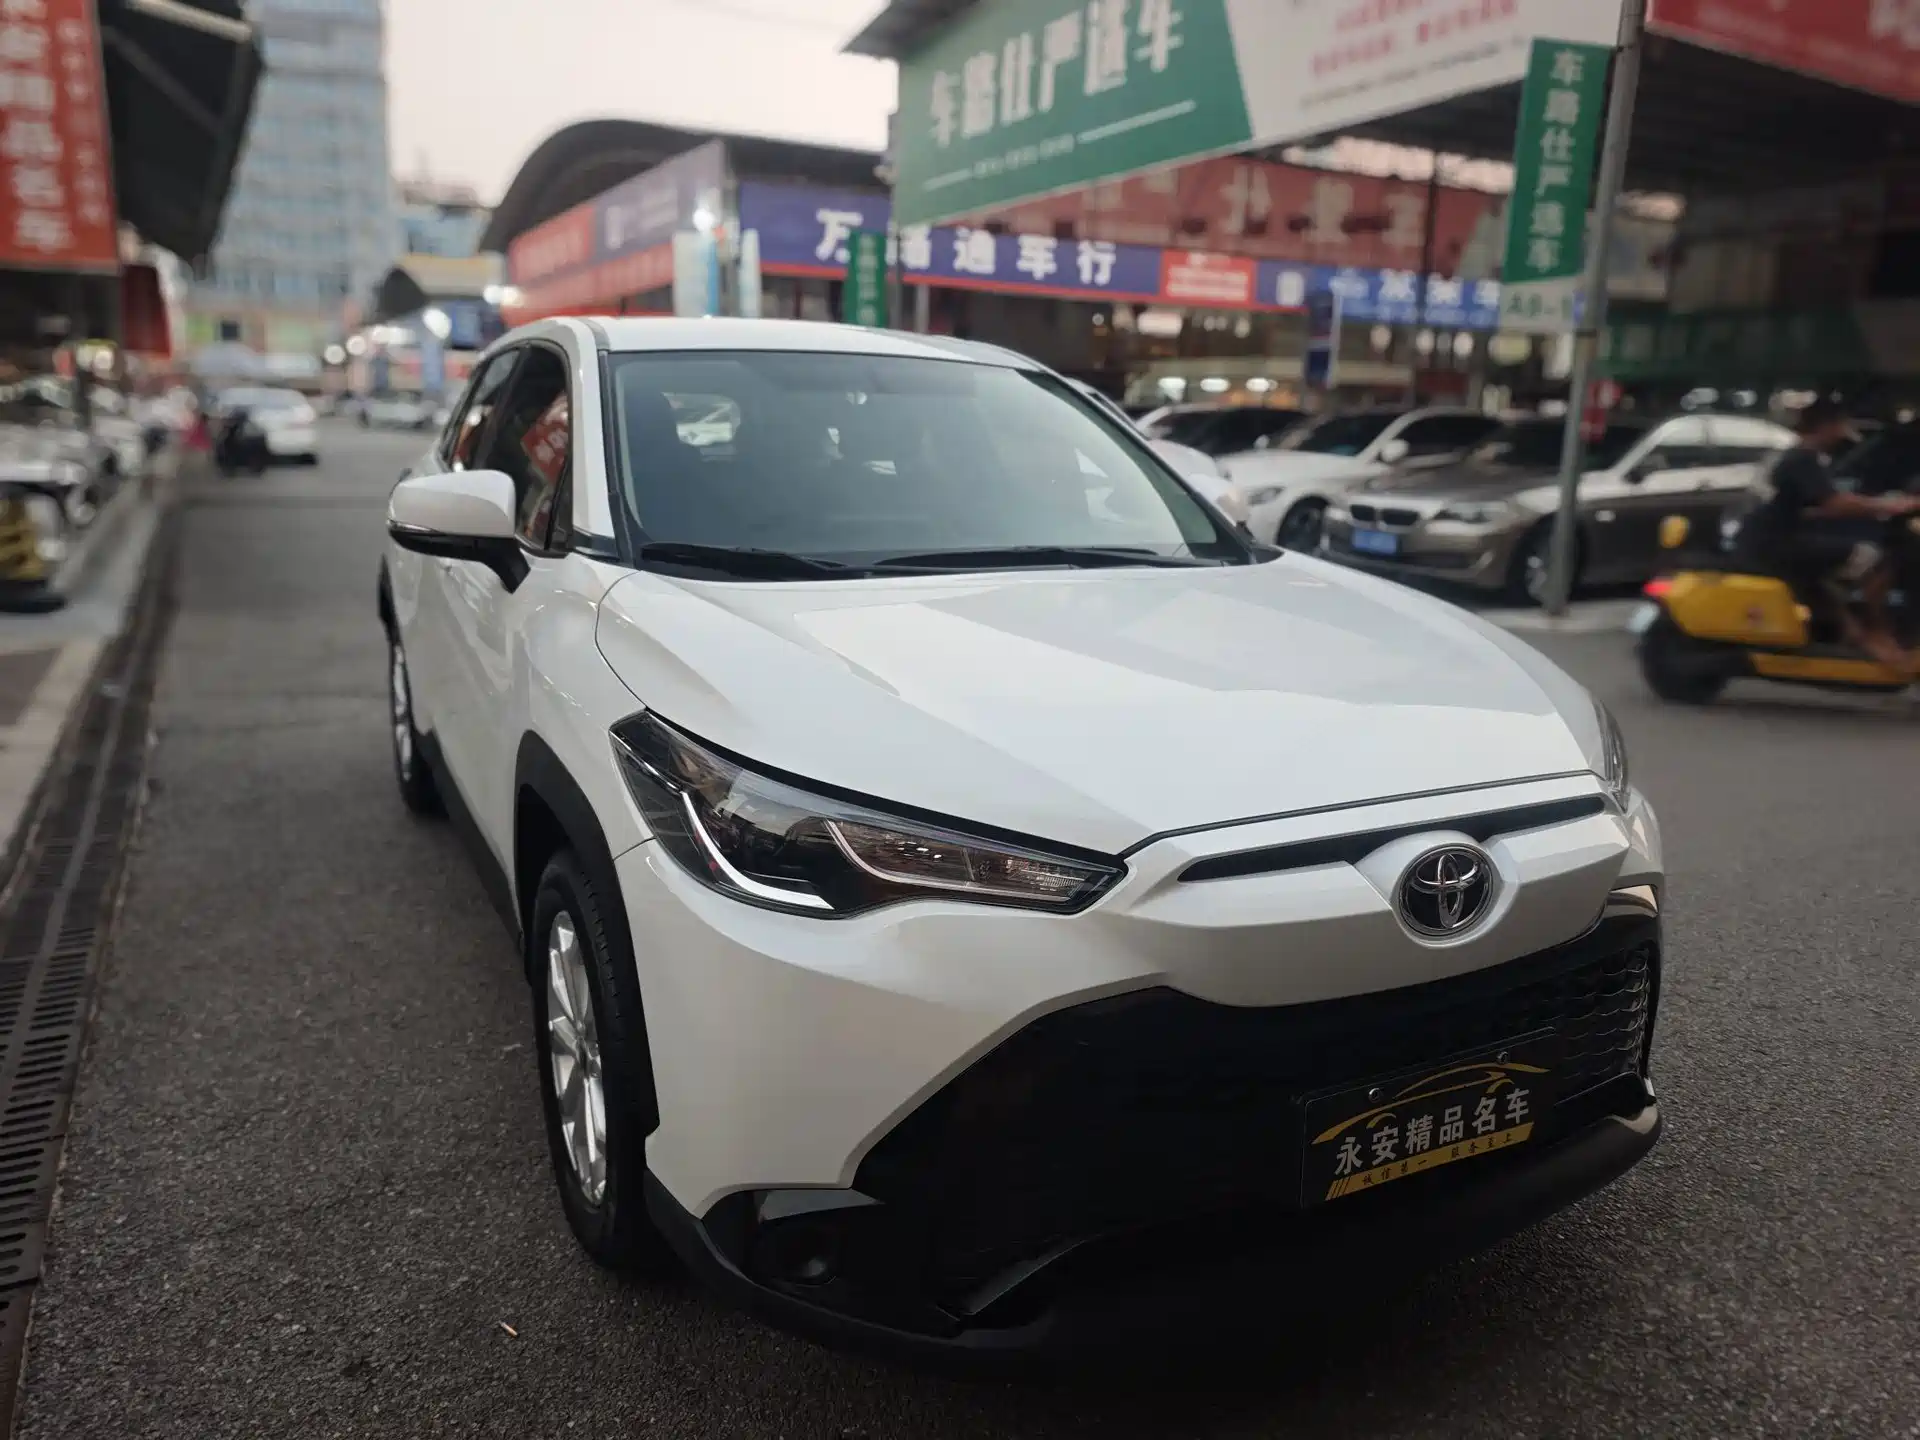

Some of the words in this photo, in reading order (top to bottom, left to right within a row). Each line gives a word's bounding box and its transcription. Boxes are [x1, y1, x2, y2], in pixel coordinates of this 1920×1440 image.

[1334, 1087, 1530, 1176] 永安精品名车
